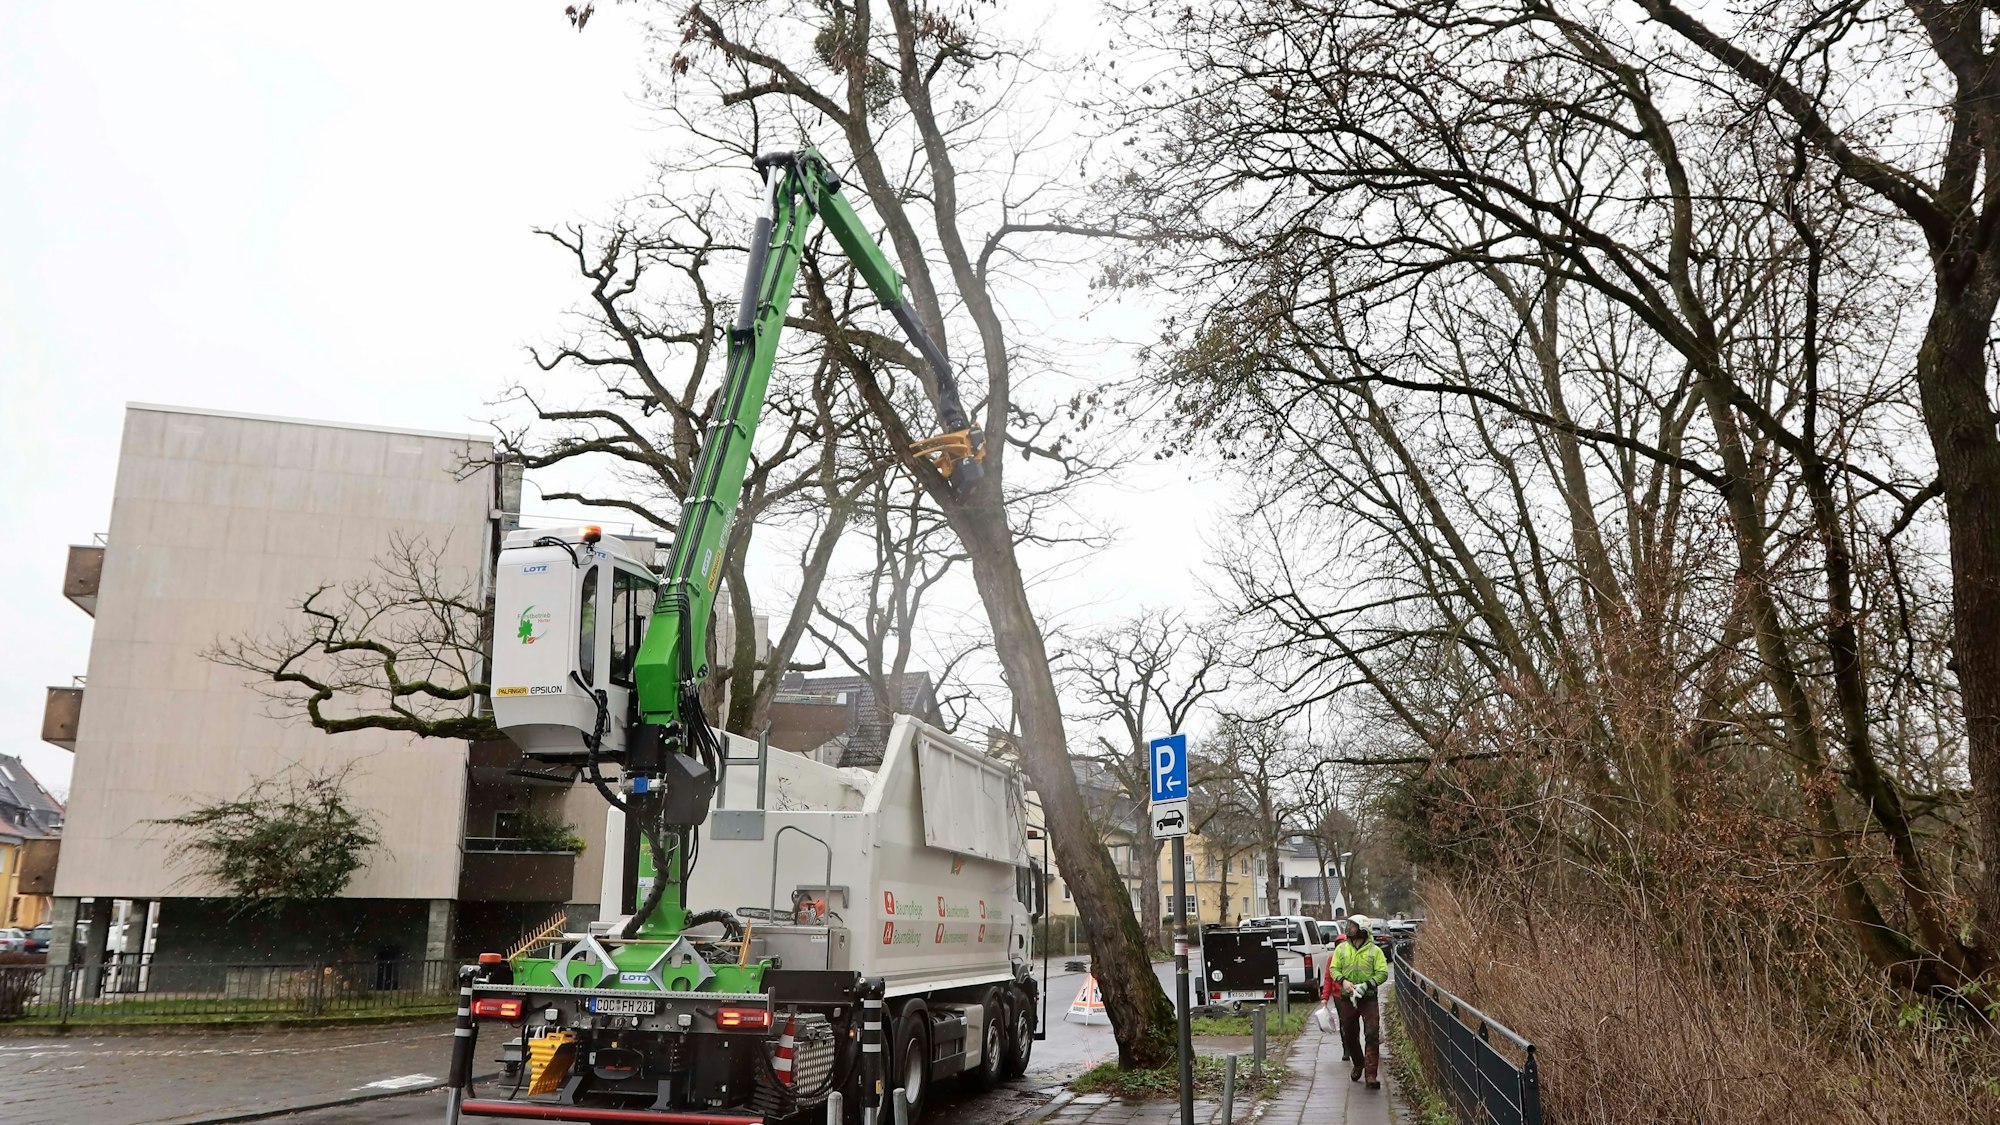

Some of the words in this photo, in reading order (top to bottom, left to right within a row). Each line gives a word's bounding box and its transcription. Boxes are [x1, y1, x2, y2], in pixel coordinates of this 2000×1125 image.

[719, 507, 733, 548] EPSILON
[586, 547, 606, 558] LTZ
[523, 565, 548, 573] LOTZ
[530, 685, 563, 694] EPSILON
[1155, 745, 1176, 794] P
[596, 999, 615, 1011] COC
[621, 1000, 635, 1012] FH
[636, 1001, 654, 1013] 281
